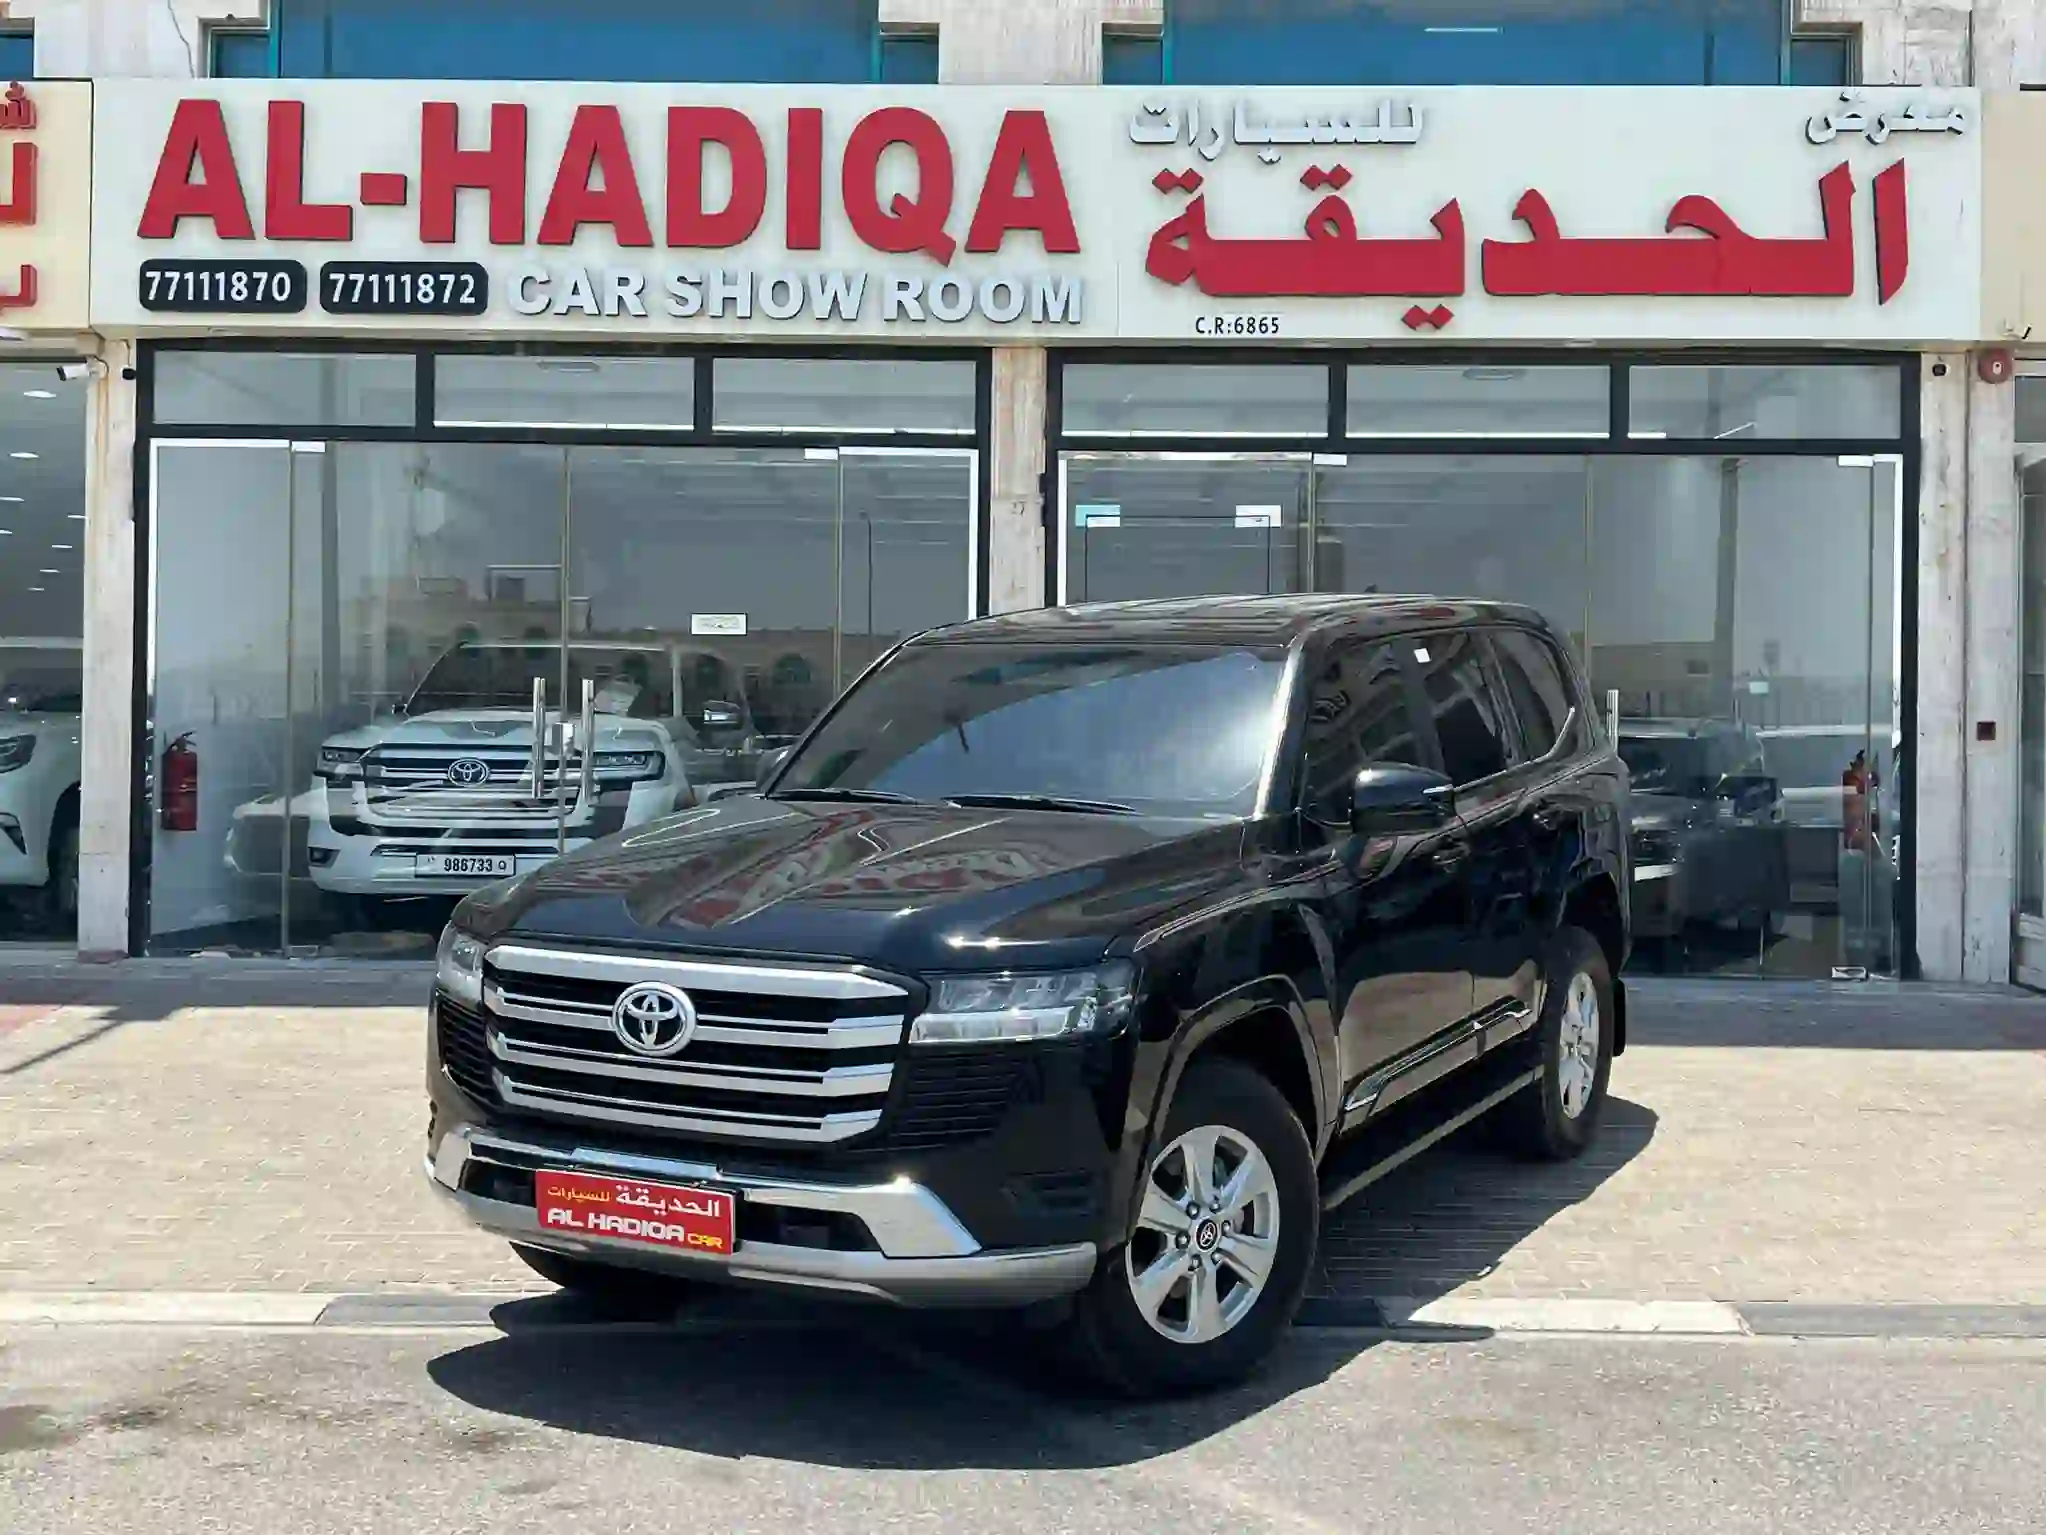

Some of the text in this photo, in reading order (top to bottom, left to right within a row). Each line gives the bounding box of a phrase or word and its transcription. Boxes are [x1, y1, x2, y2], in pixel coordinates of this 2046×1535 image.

[1128, 99, 1424, 165] للسيارات
[1805, 87, 1965, 146] معرض
[137, 98, 1081, 267] AL-HADIQA
[1146, 157, 1908, 331] الحديقة
[145, 270, 292, 302] 77111870
[328, 272, 476, 304] 77111872
[507, 267, 1082, 325] CAR SHOW ROOM
[1195, 316, 1281, 334] C.R:6865
[443, 857, 493, 872] 986733
[547, 1184, 720, 1218] الحديقة للسيارات
[547, 1207, 584, 1228] AL
[687, 1232, 723, 1249] CAR
